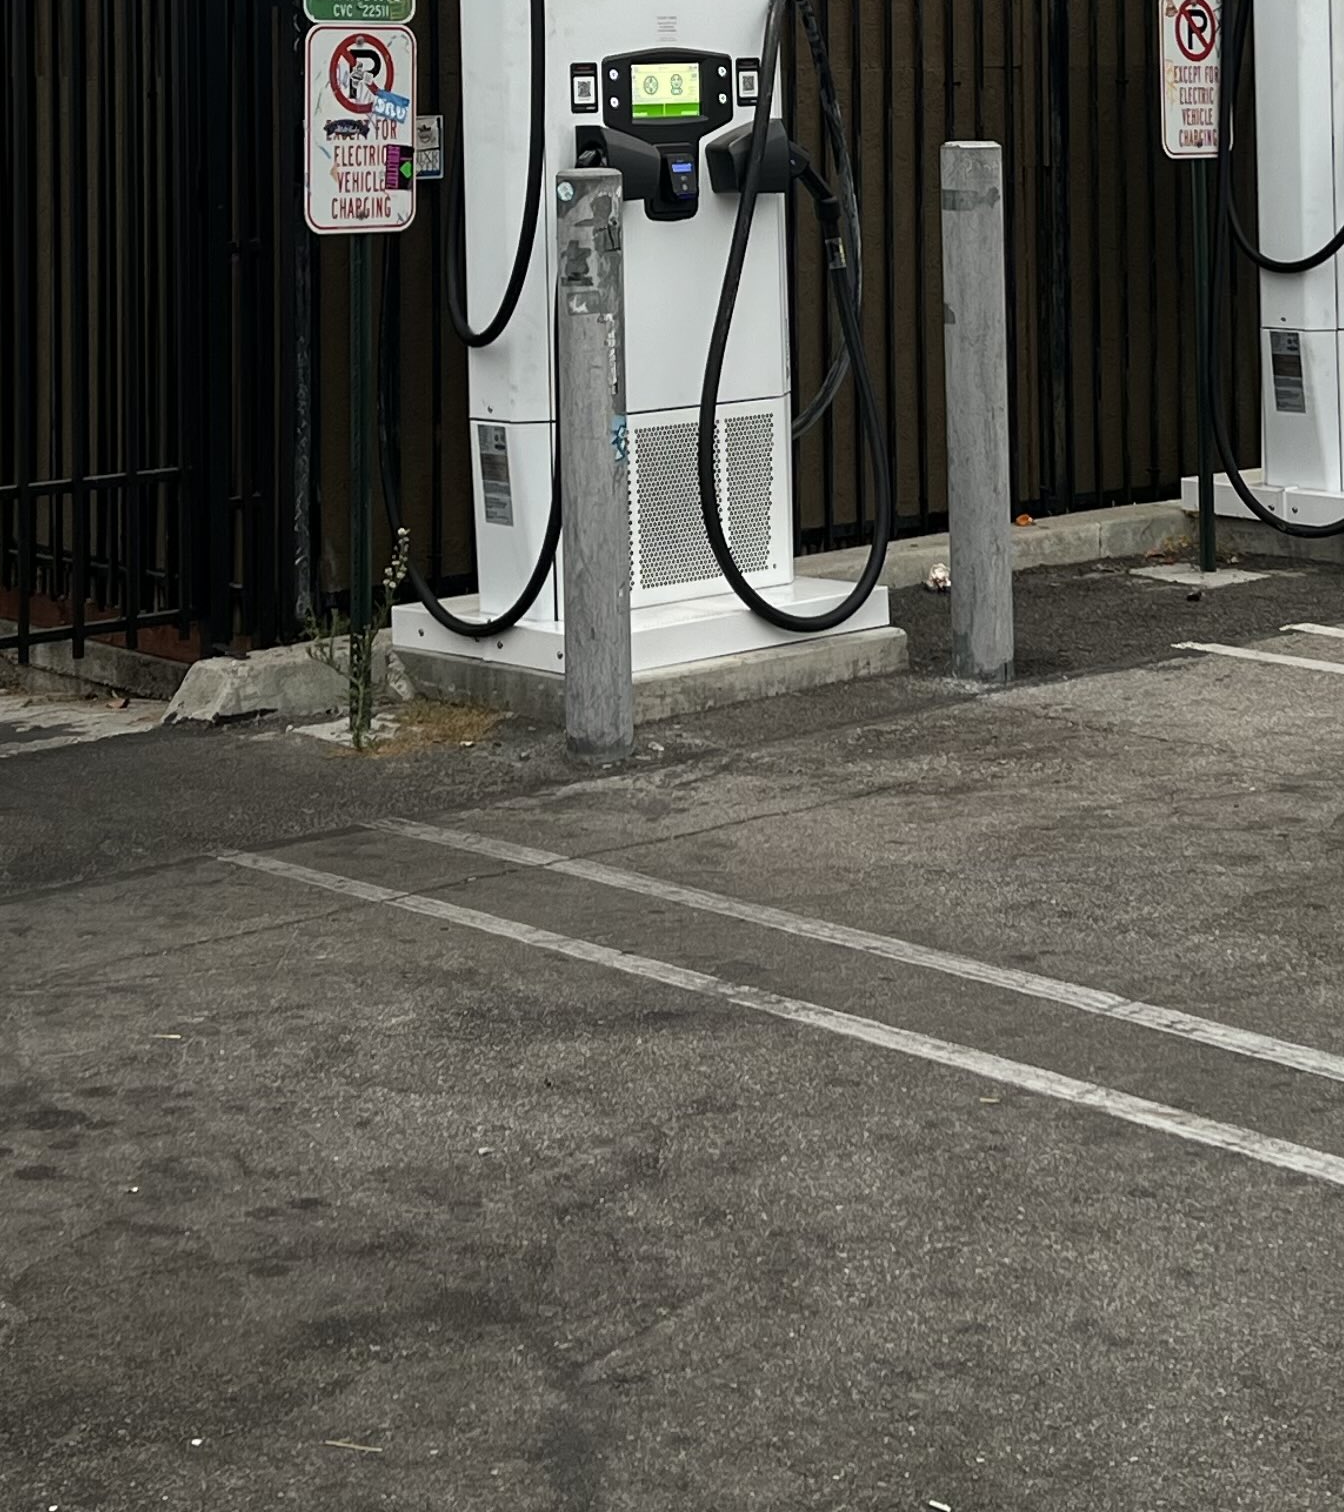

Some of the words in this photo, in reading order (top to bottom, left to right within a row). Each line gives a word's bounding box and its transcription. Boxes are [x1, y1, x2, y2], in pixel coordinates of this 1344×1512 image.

[333, 4, 353, 17] CVC
[1174, 66, 1201, 84] EXCEPT
[1179, 87, 1214, 105] ELECTRIC
[1181, 108, 1214, 126] VEHICLE
[376, 119, 397, 140] FOR
[331, 196, 391, 219] CHARGING
